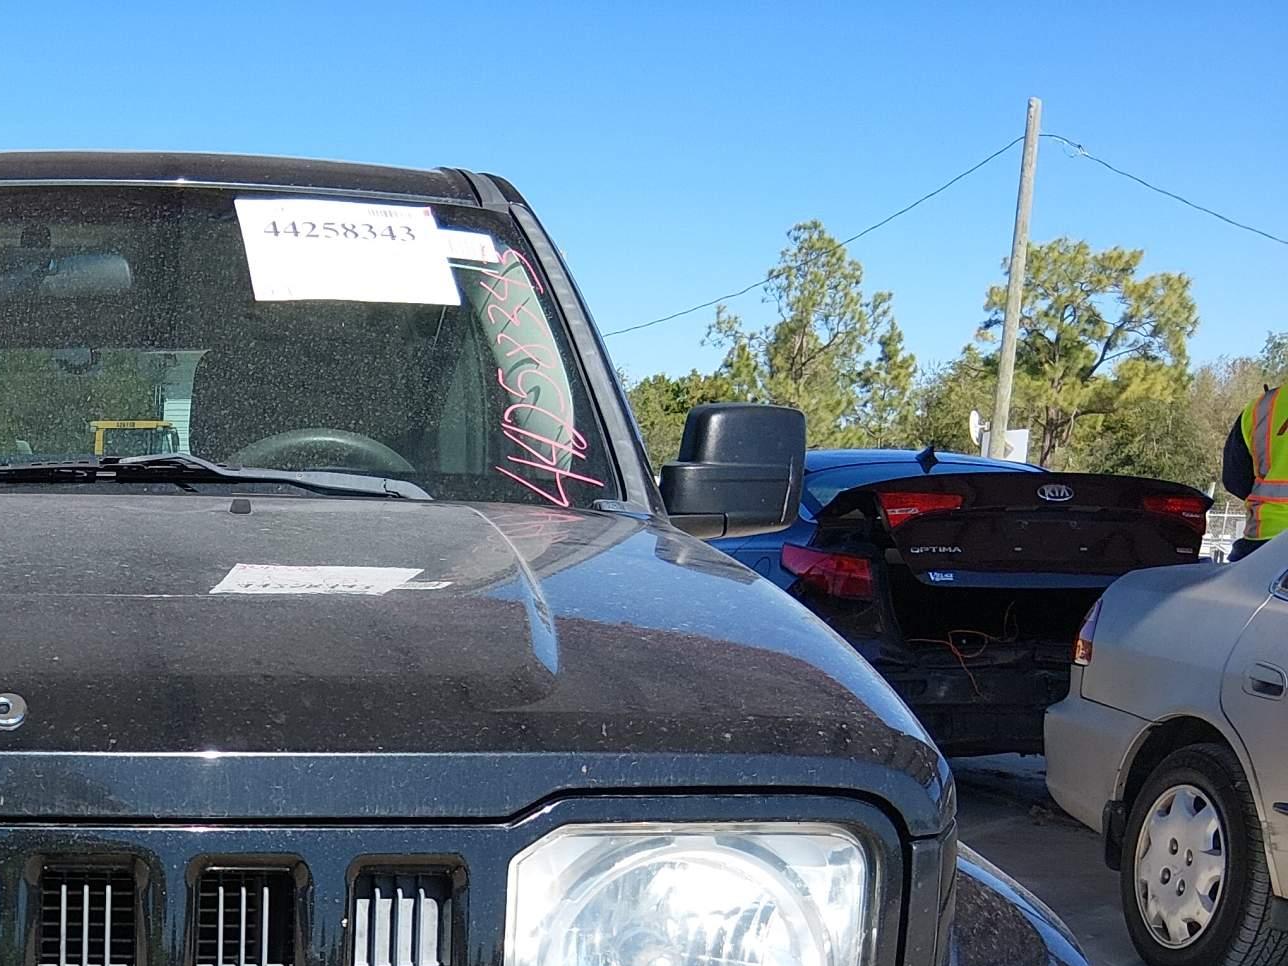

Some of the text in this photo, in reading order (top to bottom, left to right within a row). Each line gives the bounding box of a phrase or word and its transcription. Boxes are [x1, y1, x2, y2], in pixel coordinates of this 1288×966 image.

[263, 219, 416, 242] 44258343
[1042, 485, 1072, 498] KIA
[910, 545, 962, 554] OPTIMA
